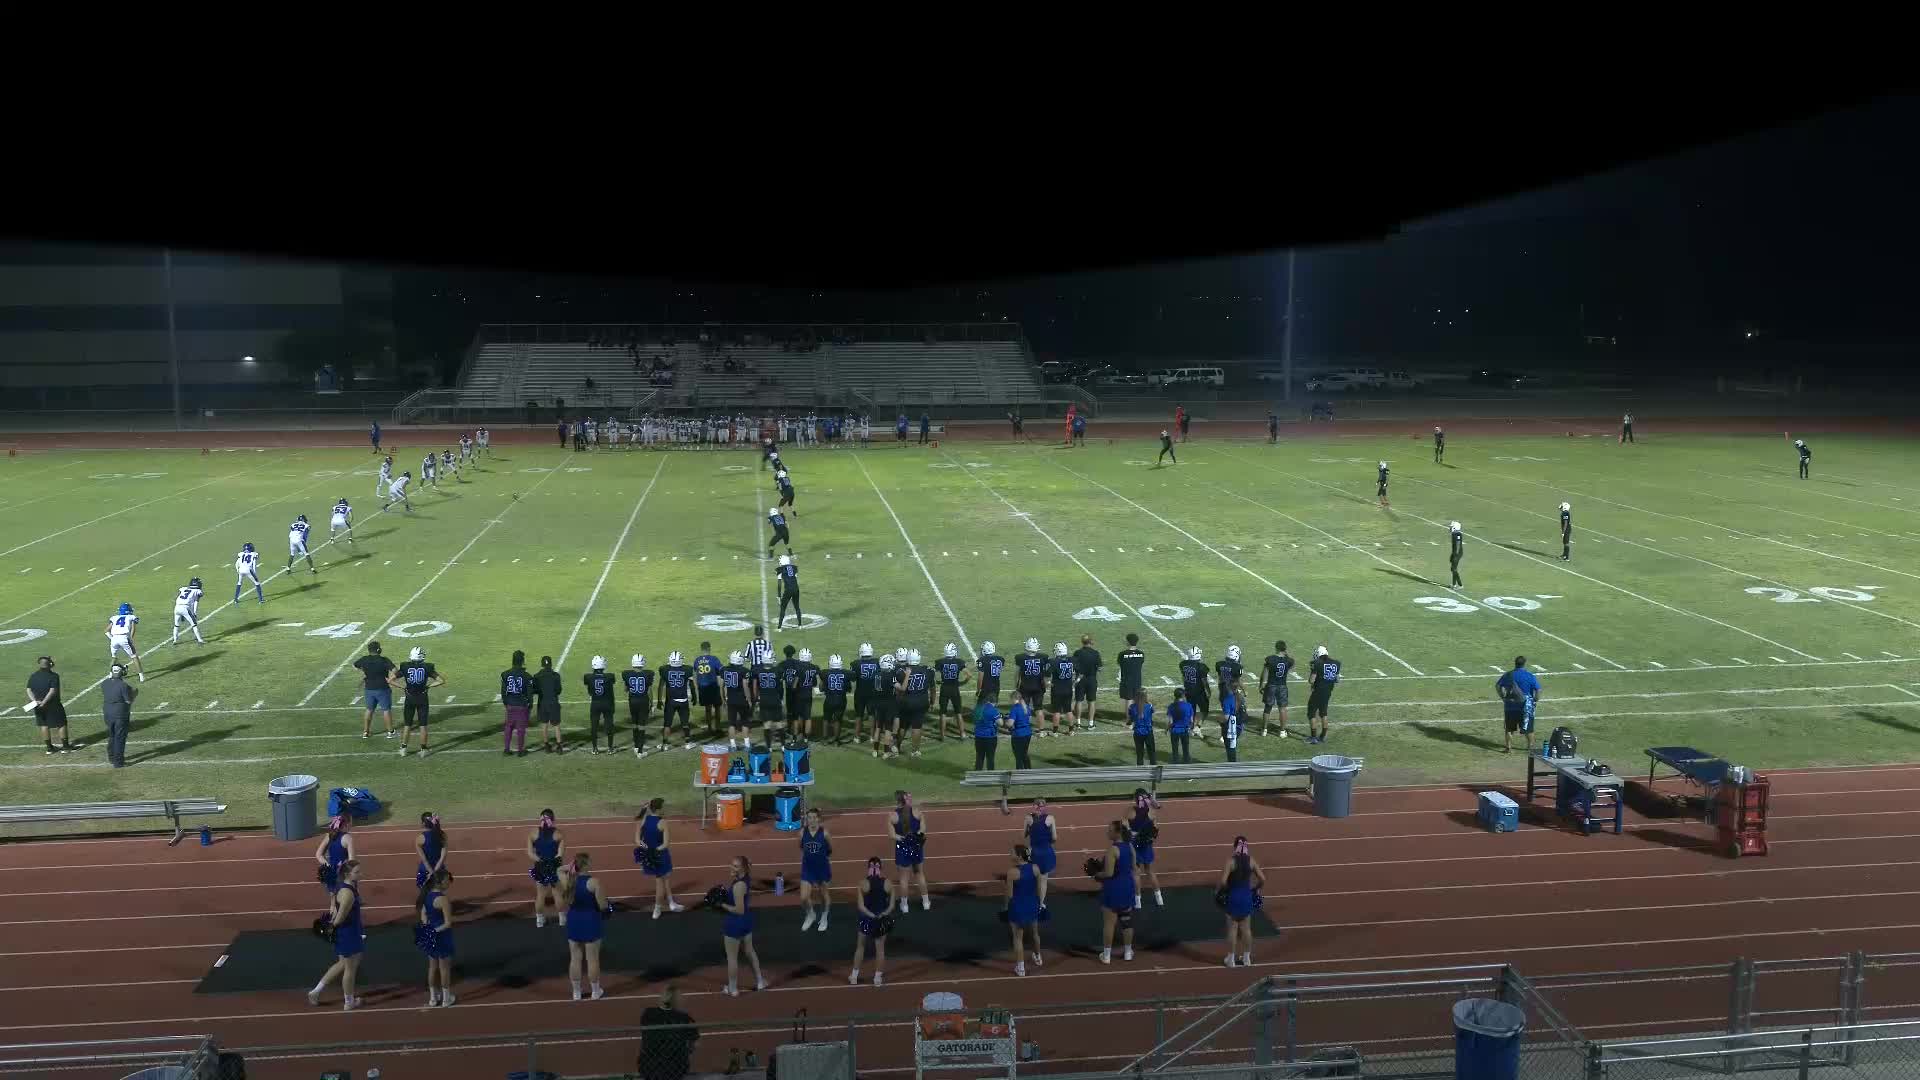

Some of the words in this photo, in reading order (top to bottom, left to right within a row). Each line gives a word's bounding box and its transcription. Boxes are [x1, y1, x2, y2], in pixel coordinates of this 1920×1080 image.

[241, 554, 252, 564] 14
[179, 589, 192, 600] 3
[1744, 586, 1876, 603] 20
[1072, 604, 1195, 622] 40
[1413, 596, 1542, 613] 30
[115, 616, 127, 628] 4
[304, 620, 453, 639] 40
[694, 613, 830, 632] 50
[407, 667, 426, 685] 30
[698, 665, 711, 675] 30
[1024, 659, 1041, 676] 75
[1275, 662, 1286, 678] 3
[594, 679, 604, 696] 5
[668, 670, 686, 688] 55
[723, 671, 739, 688] 50
[827, 673, 845, 691] 65
[937, 1042, 995, 1053] GATORADE
